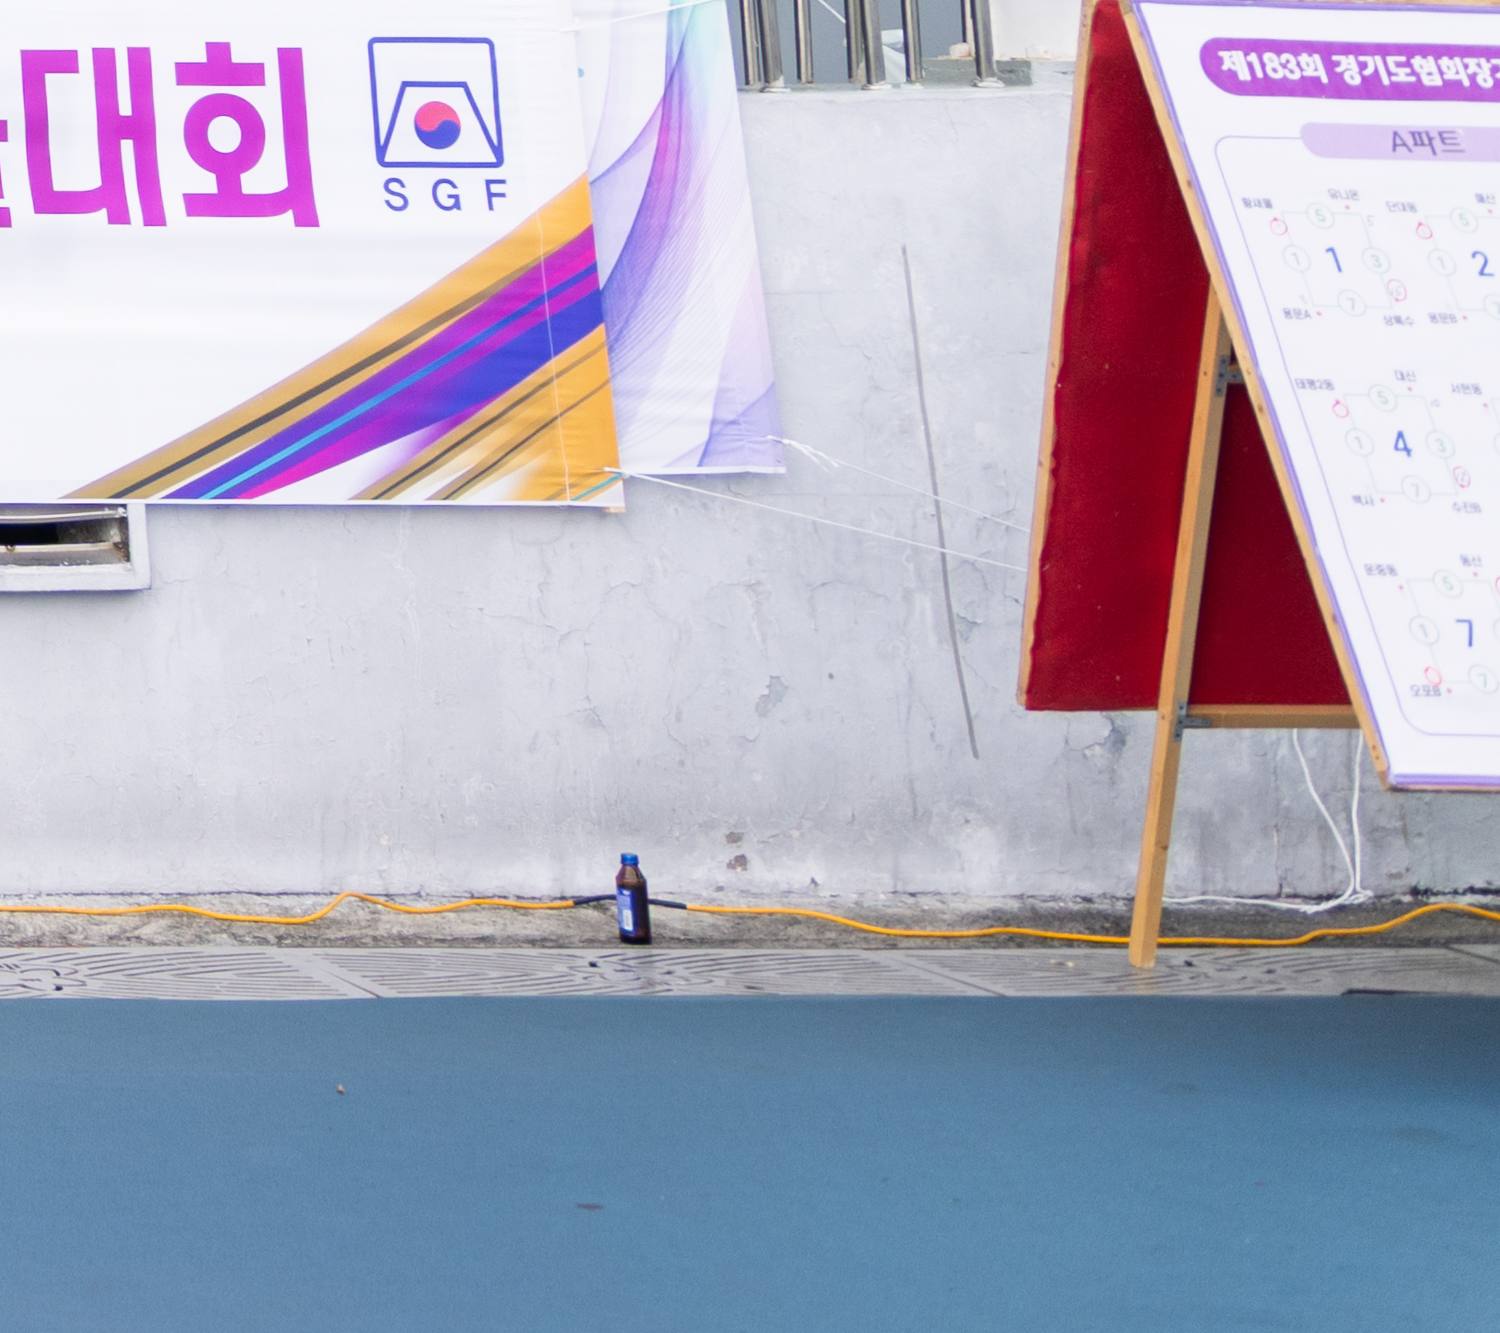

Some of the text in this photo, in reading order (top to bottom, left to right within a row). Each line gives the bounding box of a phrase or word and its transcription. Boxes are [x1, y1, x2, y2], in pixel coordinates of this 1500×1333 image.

[1217, 50, 1500, 89] 제183회 경기도협회장
[1391, 129, 1466, 156] A파트
[383, 177, 507, 212] SGF
[1314, 208, 1326, 223] 5
[1325, 246, 1343, 273] 1
[1370, 254, 1382, 269] 3
[1471, 250, 1495, 277] 2
[1376, 390, 1389, 405] 5
[1393, 430, 1413, 458] 4
[1434, 437, 1447, 452] 3
[1410, 483, 1420, 498] 7
[1455, 618, 1473, 648] 7
